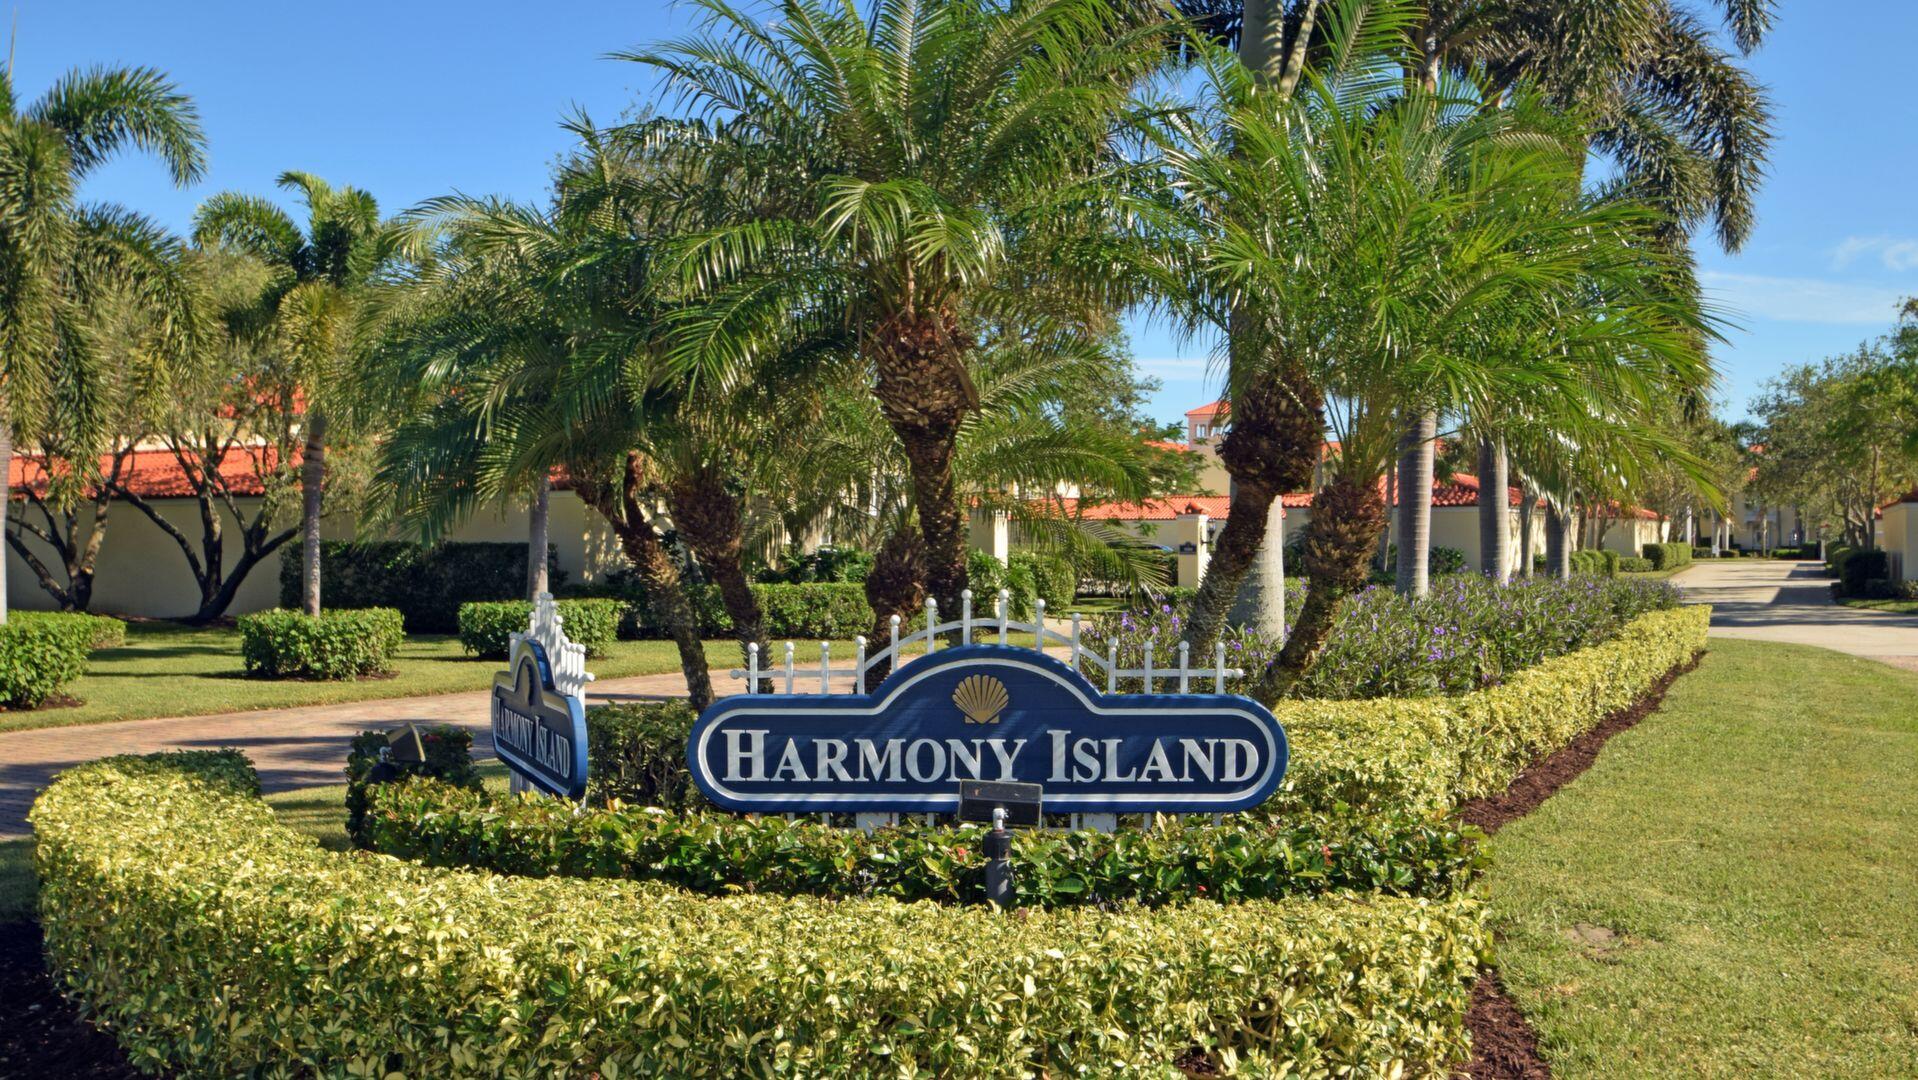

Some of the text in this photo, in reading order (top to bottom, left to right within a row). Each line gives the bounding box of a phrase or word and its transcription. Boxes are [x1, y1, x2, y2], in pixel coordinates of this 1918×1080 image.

[495, 697, 570, 779] HARMONY ISLAND
[721, 729, 1260, 783] HARMONY ISLAND
